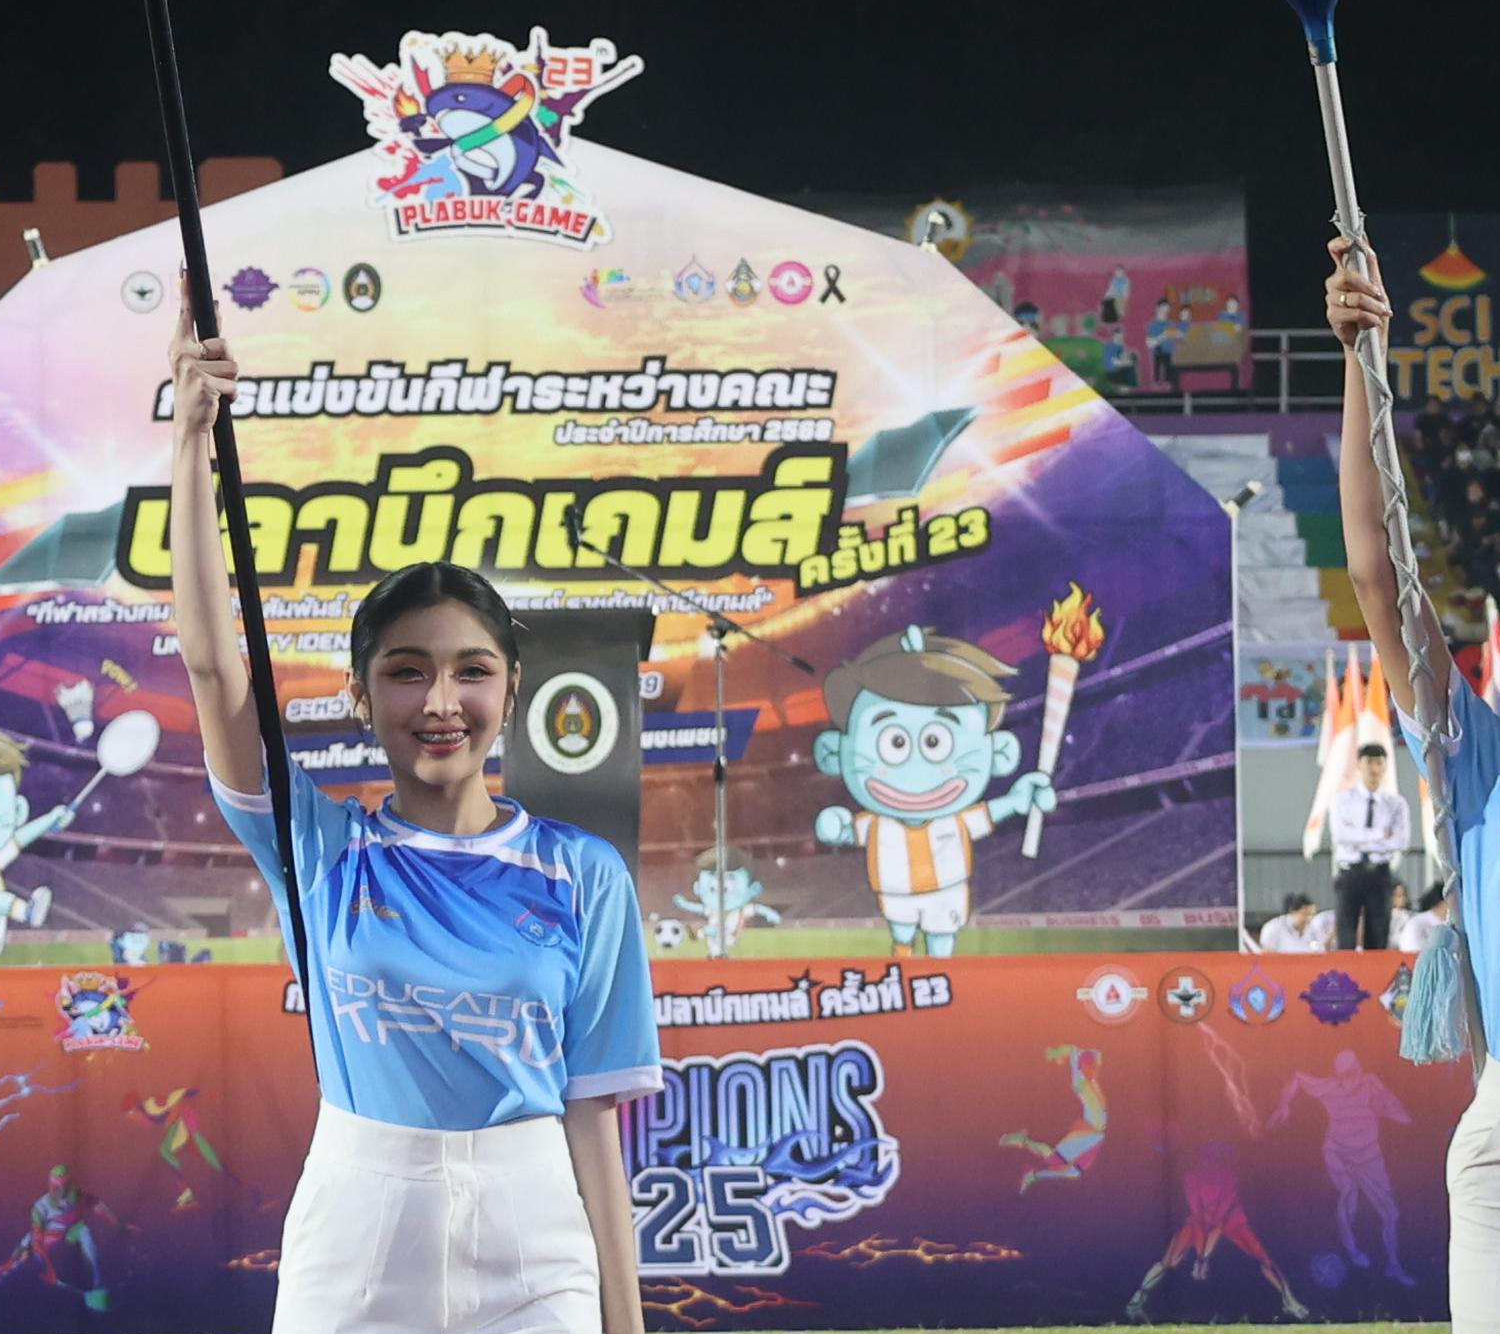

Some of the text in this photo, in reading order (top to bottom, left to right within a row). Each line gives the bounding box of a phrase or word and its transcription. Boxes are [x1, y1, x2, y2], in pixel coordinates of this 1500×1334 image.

[402, 199, 591, 236] PLABUK GAME
[1409, 293, 1493, 346] SCI
[927, 507, 989, 557] 23
[911, 977, 950, 1007] 23
[330, 991, 564, 1069] KPRU
